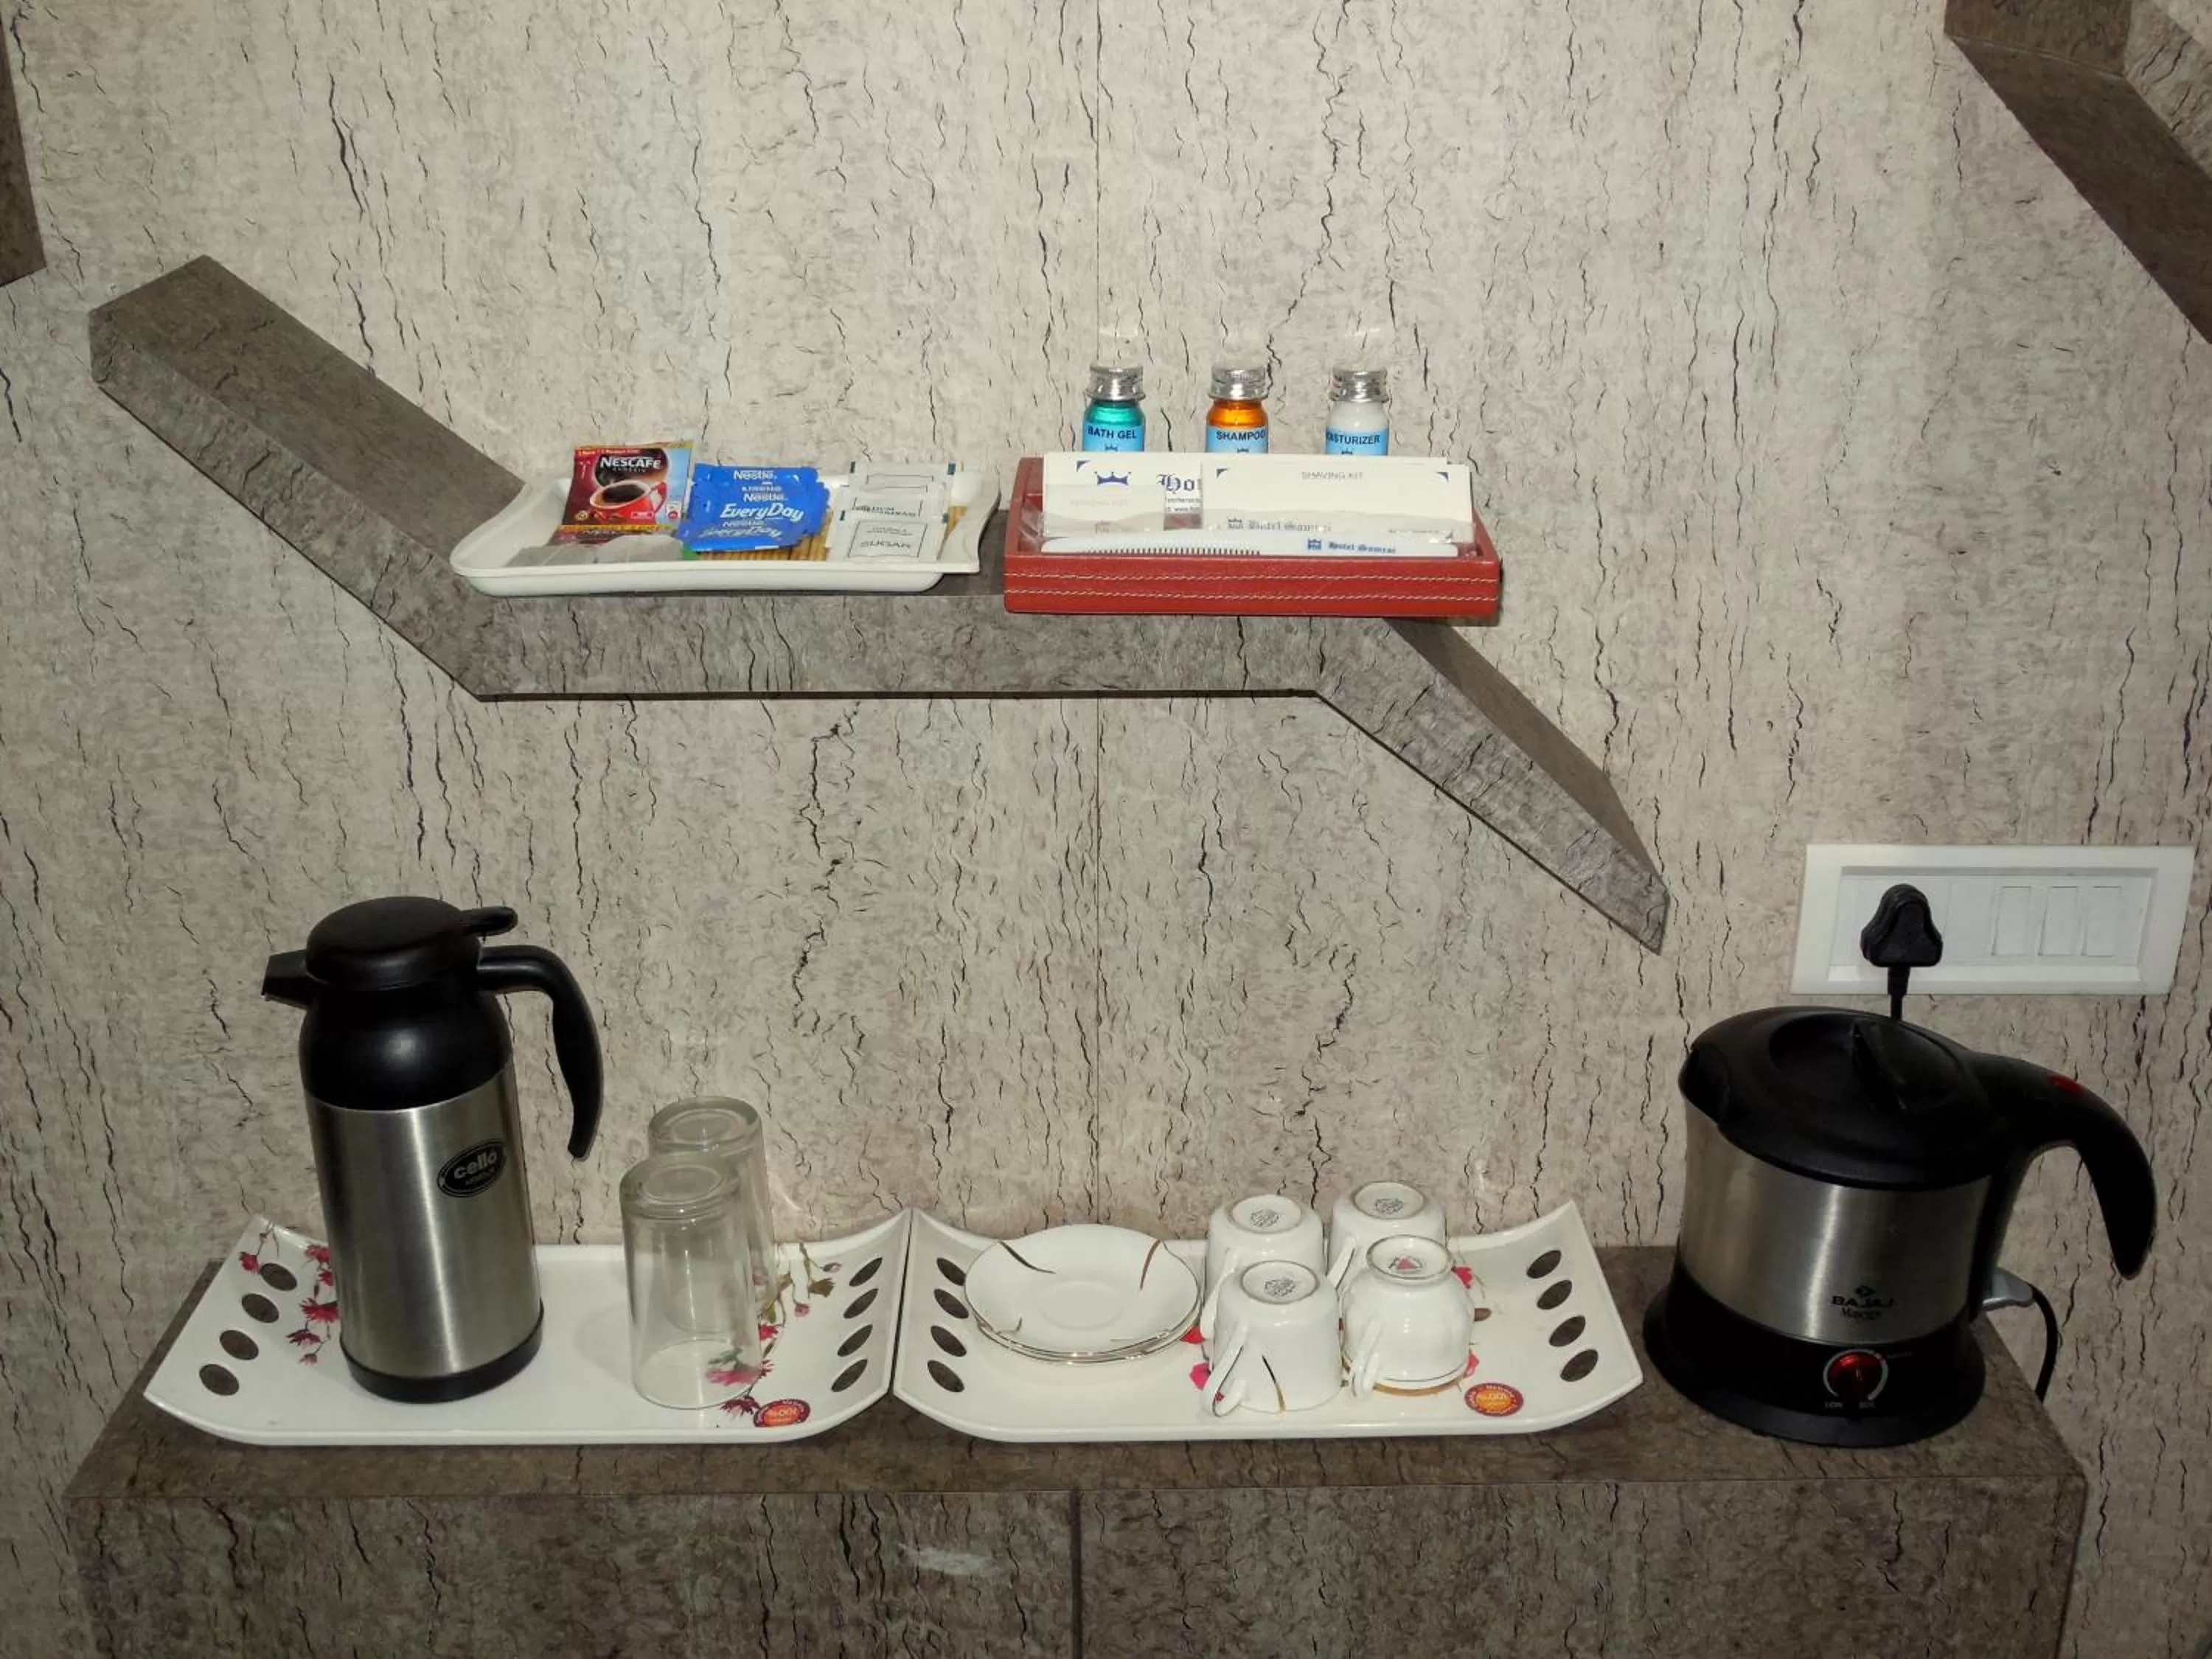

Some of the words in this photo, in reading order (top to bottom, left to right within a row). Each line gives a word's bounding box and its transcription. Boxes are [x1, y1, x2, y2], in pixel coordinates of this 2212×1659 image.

[1088, 425, 1114, 439] BATH
[1117, 430, 1137, 439] GEL
[1216, 429, 1267, 441] SHAMPOO
[720, 503, 805, 522] EveryDay
